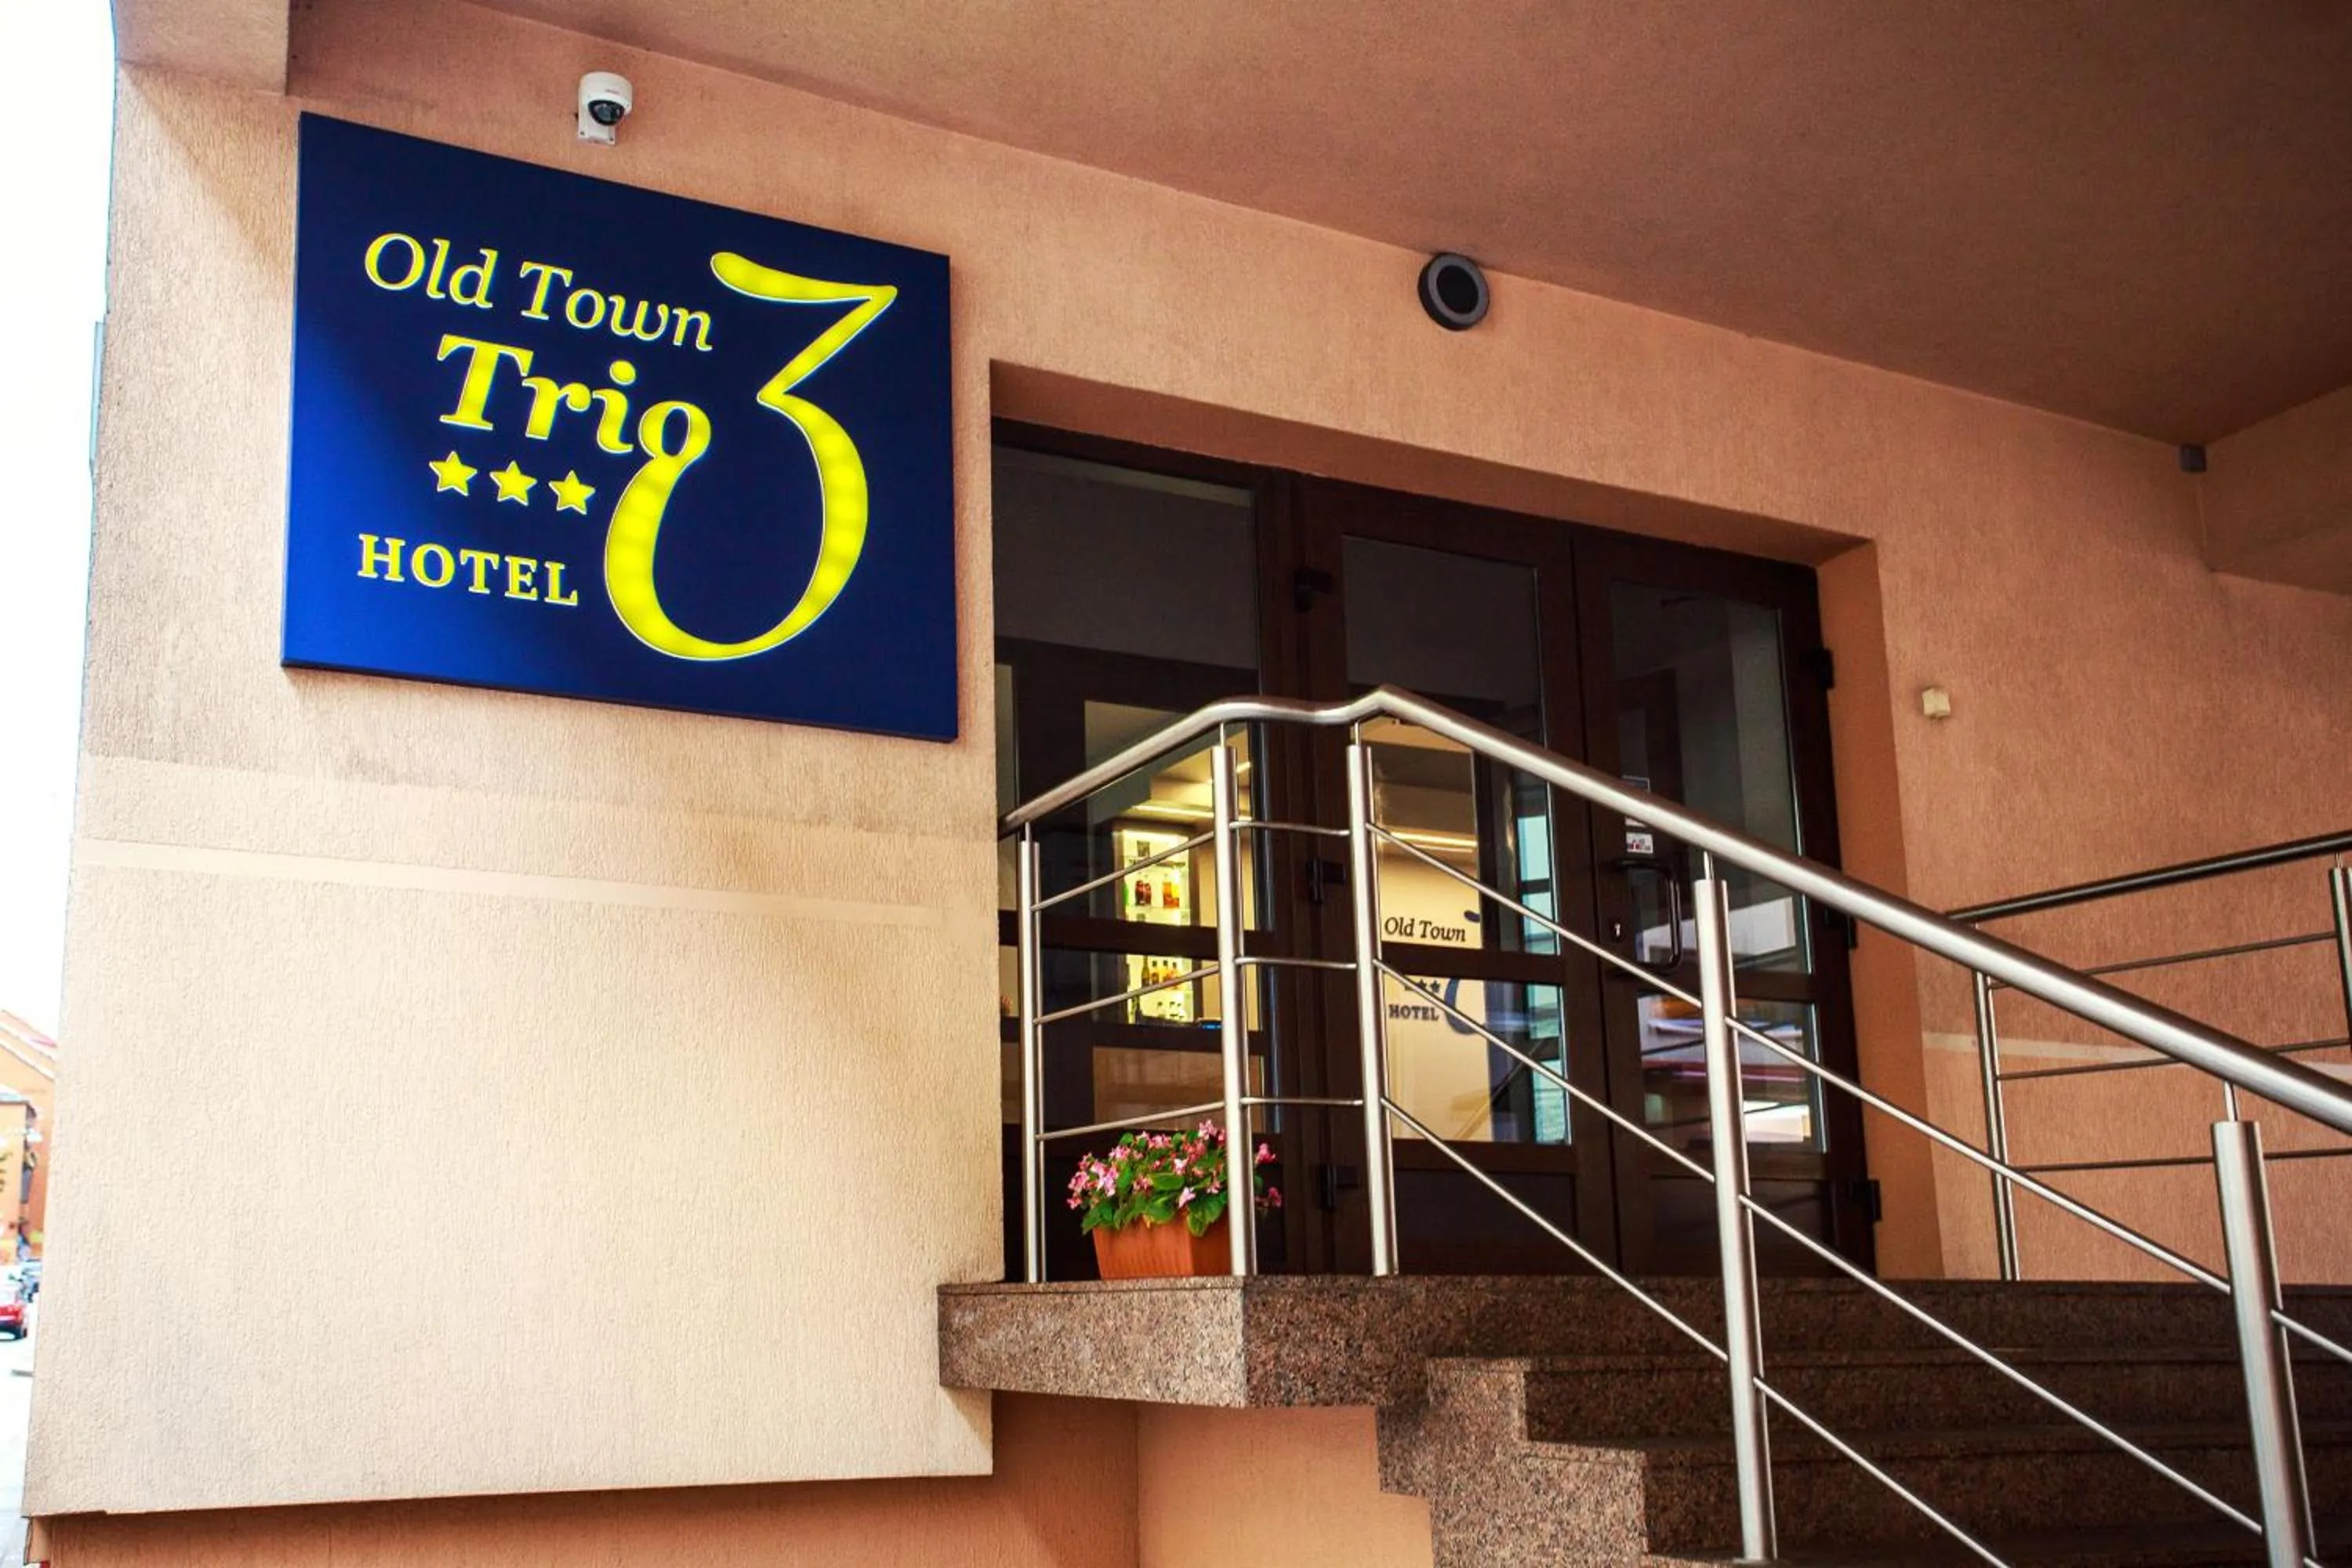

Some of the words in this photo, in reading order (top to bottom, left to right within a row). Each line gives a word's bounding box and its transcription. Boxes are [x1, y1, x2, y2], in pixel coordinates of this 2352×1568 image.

[365, 232, 498, 309] Old
[519, 261, 713, 351] Town
[437, 333, 712, 461] Trio
[357, 533, 579, 607] HOTEL
[1385, 916, 1415, 938] Old
[1419, 920, 1466, 942] Town
[1388, 1004, 1439, 1022] HOTEL
